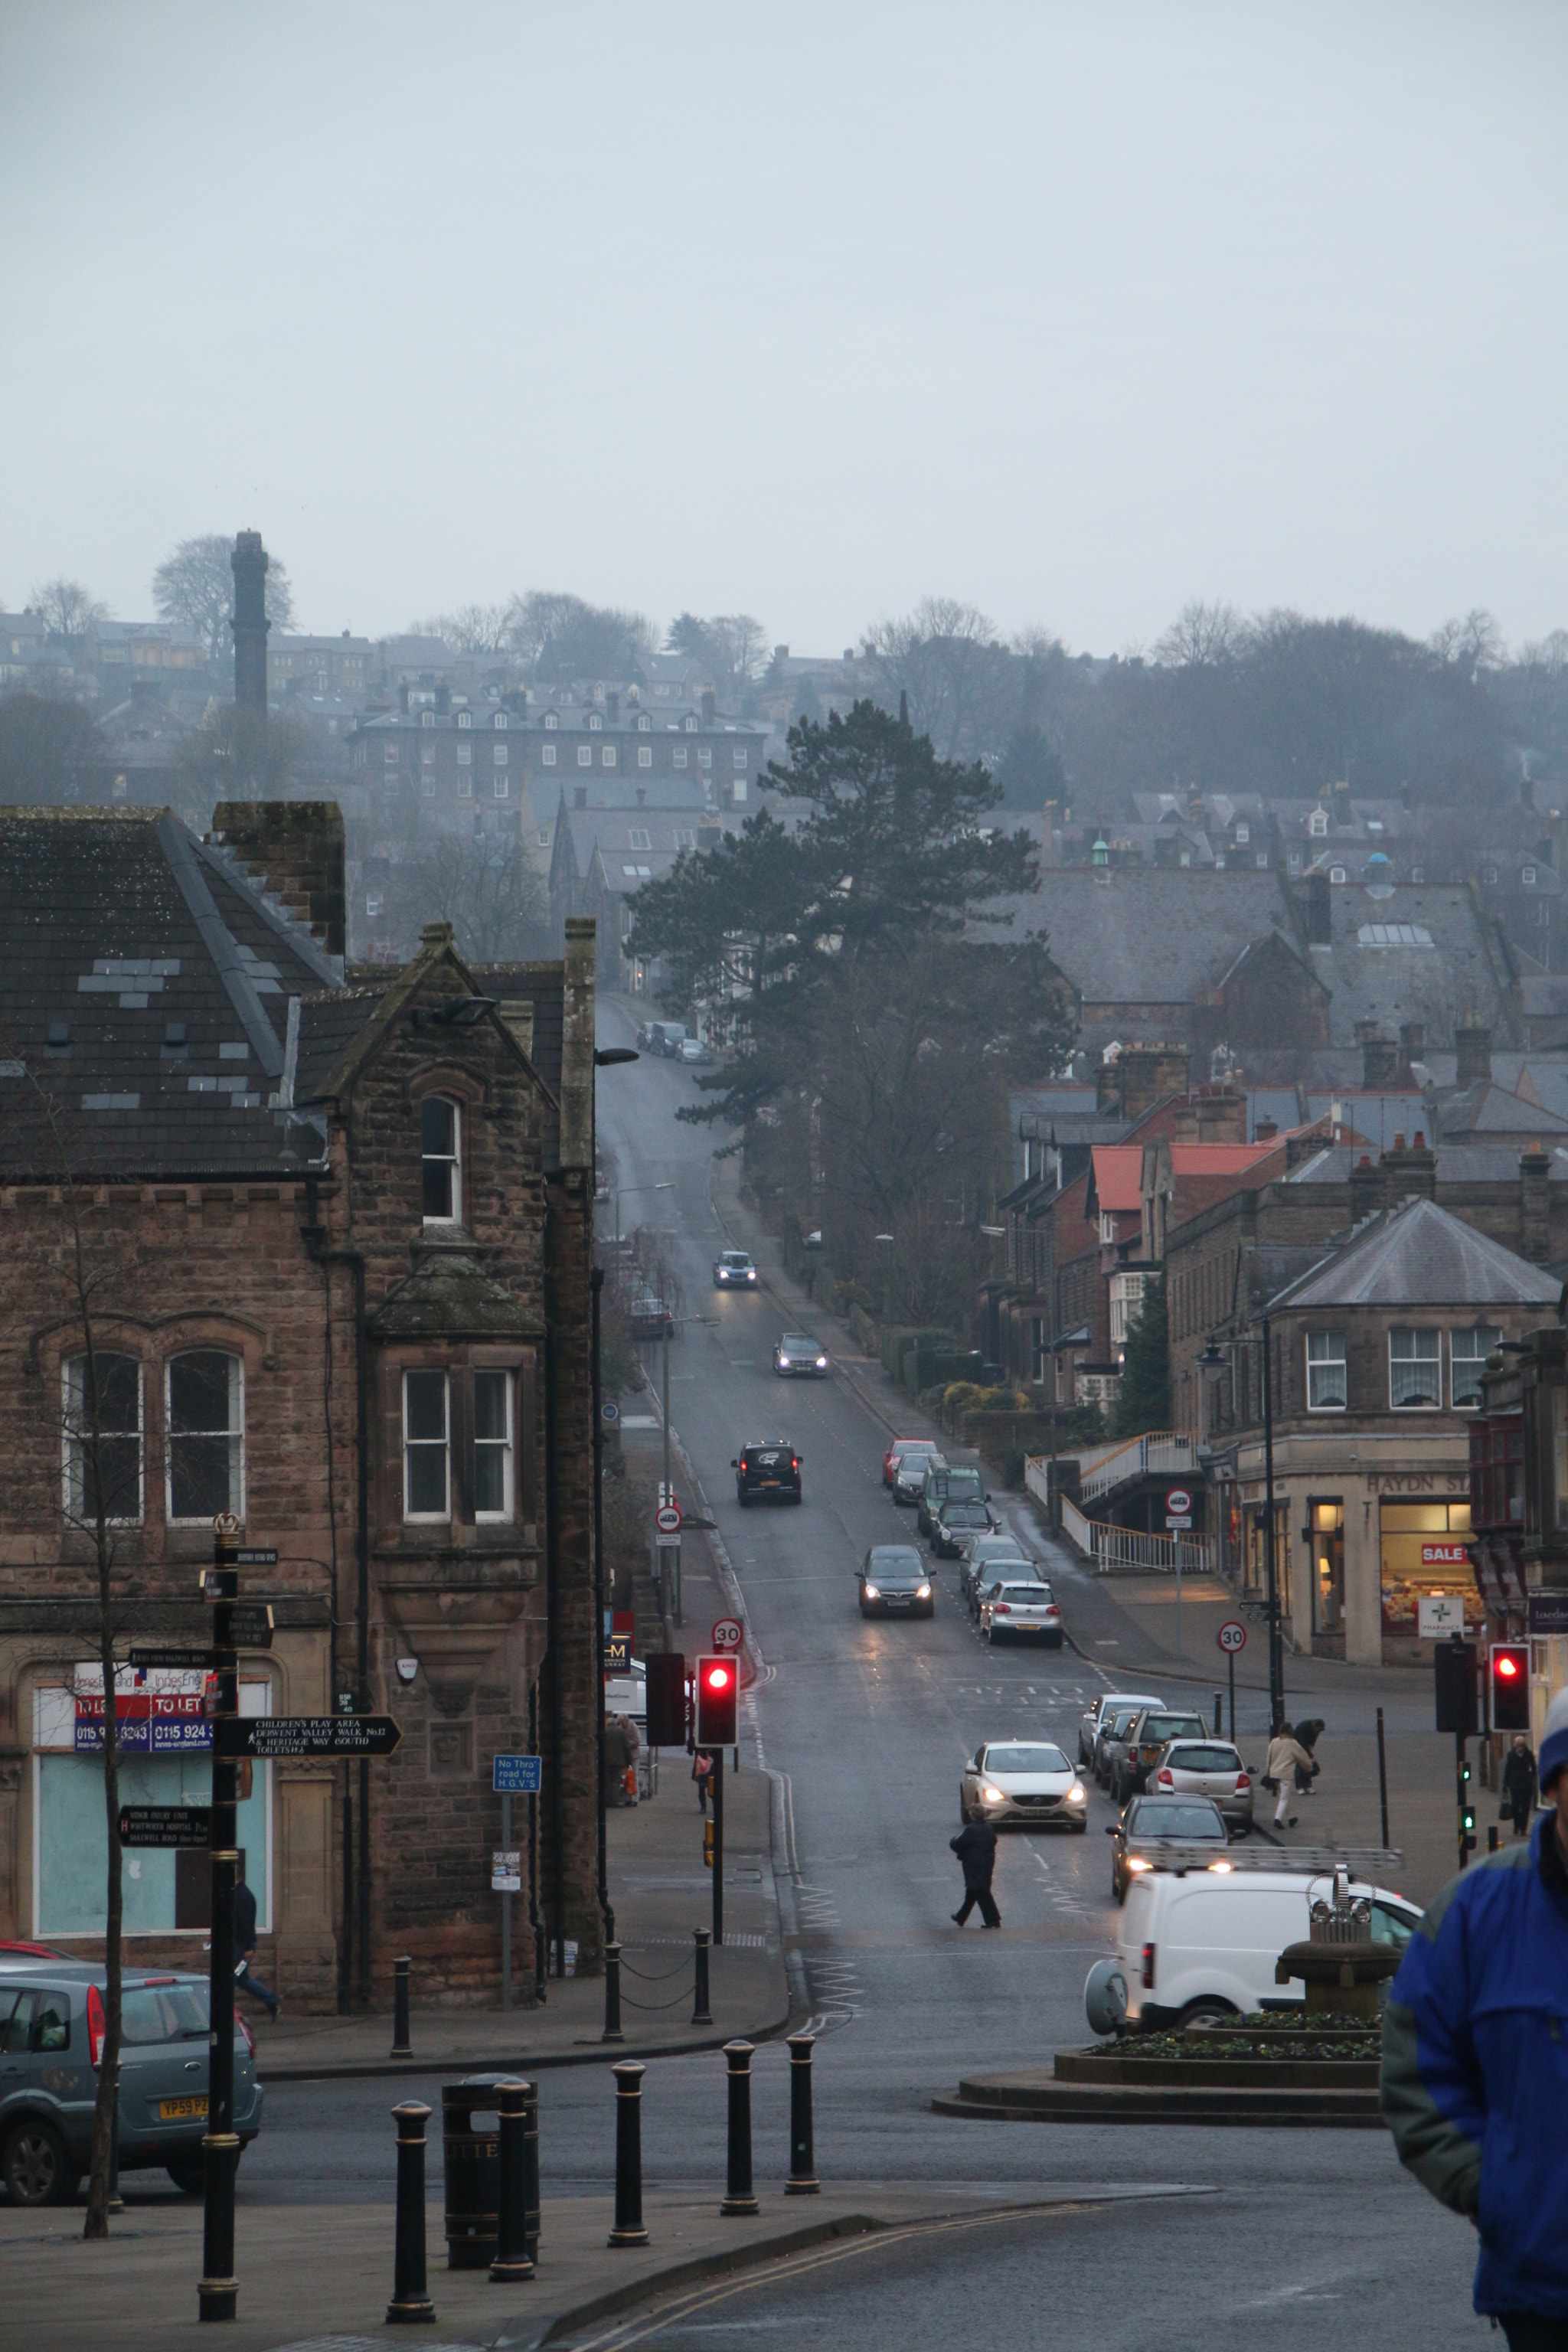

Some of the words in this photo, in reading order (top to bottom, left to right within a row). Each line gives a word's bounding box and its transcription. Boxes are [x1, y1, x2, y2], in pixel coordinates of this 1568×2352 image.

[1367, 1474, 1434, 1491] HAYDN
[1423, 1547, 1463, 1561] SALE
[717, 1628, 739, 1641] 30
[1223, 1631, 1242, 1645] 30
[77, 1700, 91, 1713] TO
[94, 1700, 106, 1713] LE
[155, 1699, 173, 1713] TO
[178, 1698, 201, 1712] LET
[256, 1720, 306, 1728] CHILDREN'S
[310, 1720, 332, 1728] PLAY
[77, 1726, 96, 1740] 0115
[155, 1725, 181, 1739] 0115
[184, 1724, 205, 1738] 924
[256, 1729, 299, 1737] DERWENT
[302, 1729, 333, 1737] VALLEY
[338, 1728, 362, 1736] WALK
[267, 1737, 309, 1746] HERITAGE
[335, 1736, 369, 1746] (SOUTH)
[256, 1746, 290, 1754] TOILETS
[498, 1759, 511, 1769] No
[164, 2100, 192, 2115] YP59
